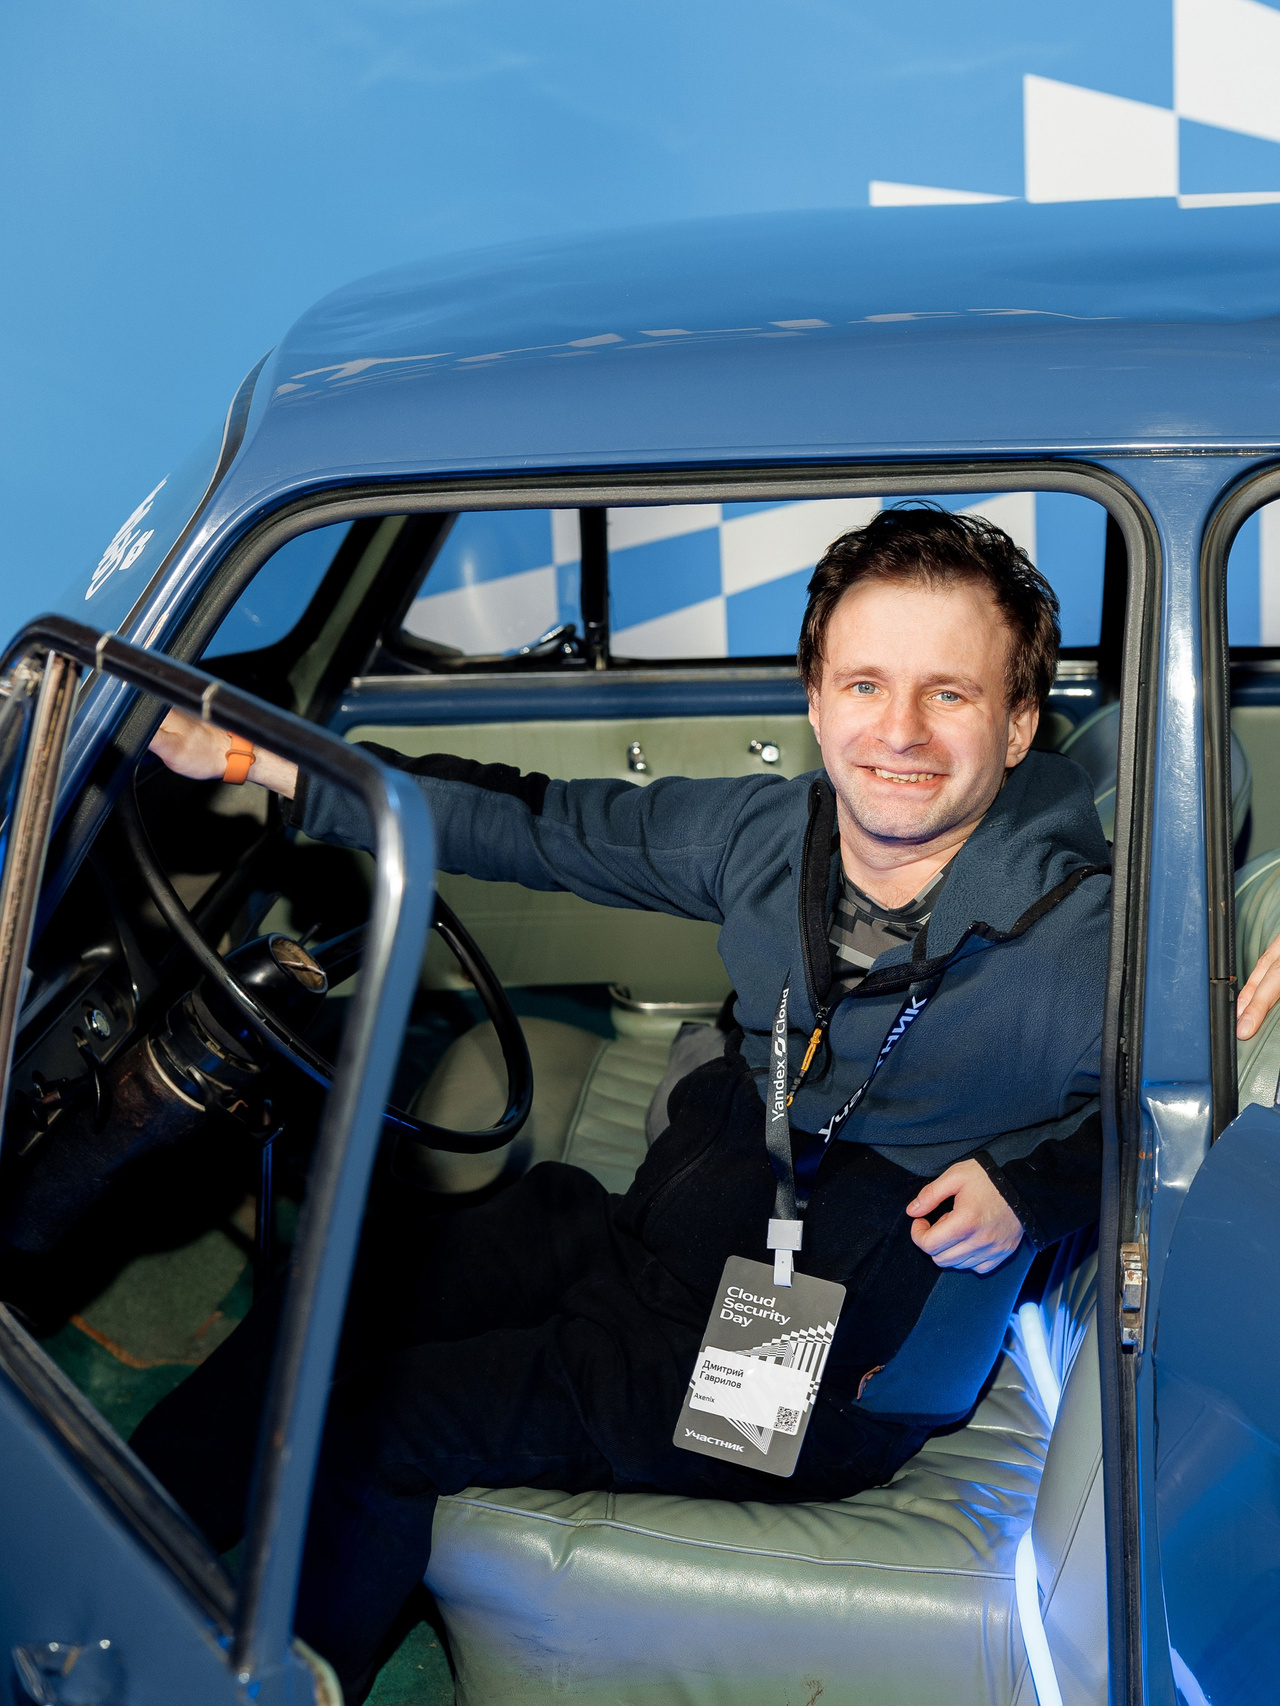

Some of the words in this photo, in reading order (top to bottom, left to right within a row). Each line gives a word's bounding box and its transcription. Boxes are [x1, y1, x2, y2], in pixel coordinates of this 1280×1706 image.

[776, 988, 789, 1034] Cloud
[771, 1060, 787, 1123] Yandex
[726, 1286, 776, 1308] Cloud
[719, 1308, 753, 1327] Day
[723, 1297, 791, 1326] Security
[702, 1360, 744, 1378] Дмитрий
[699, 1371, 742, 1389] Гаврилов
[693, 1392, 716, 1403] Axenix
